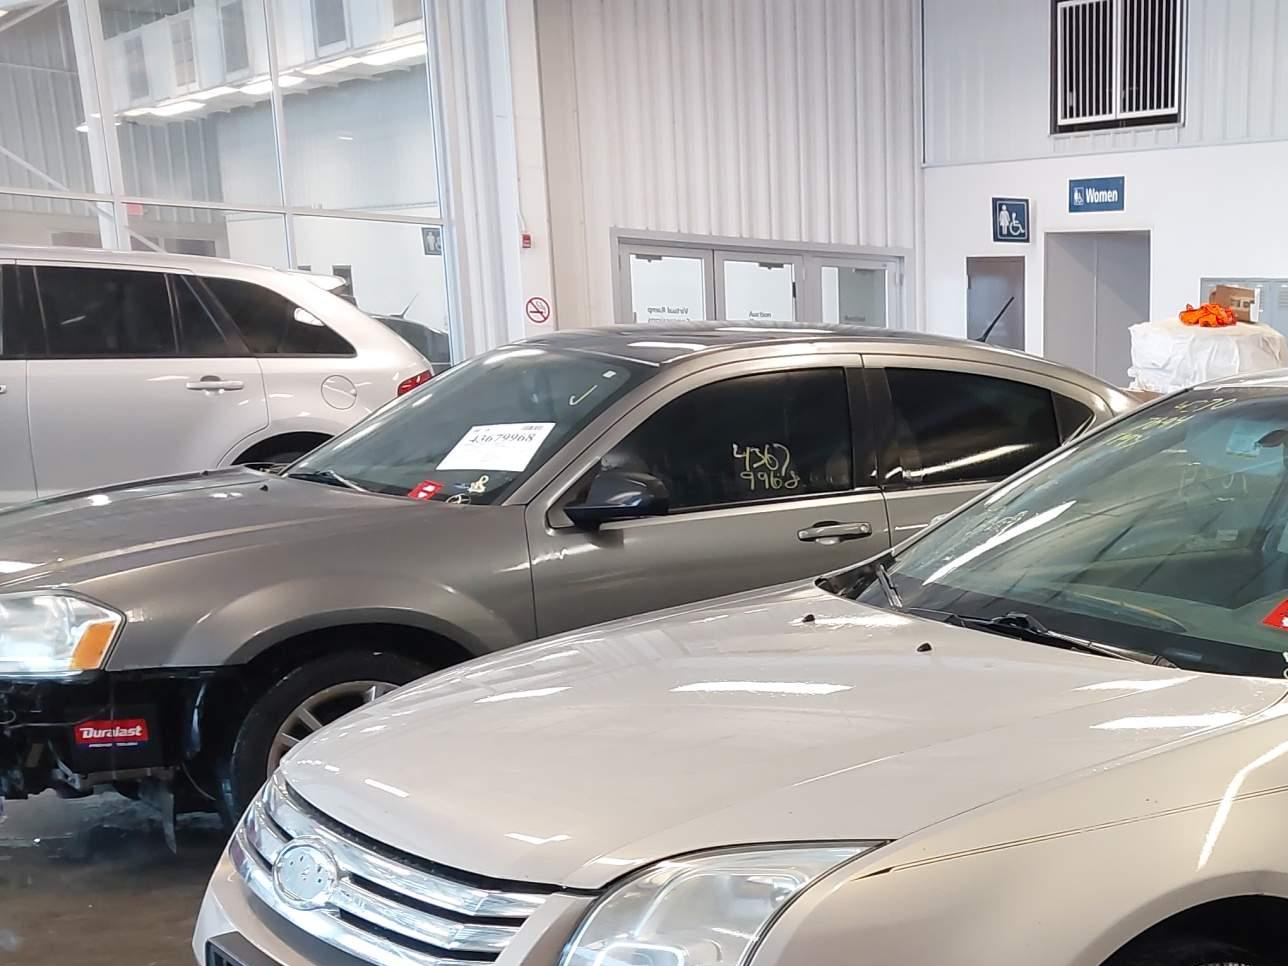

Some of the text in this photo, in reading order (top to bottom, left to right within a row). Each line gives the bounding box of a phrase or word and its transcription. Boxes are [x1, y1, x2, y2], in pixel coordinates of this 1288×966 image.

[1086, 187, 1118, 203] Women
[469, 432, 537, 444] 43679968
[80, 725, 143, 738] Duralast
